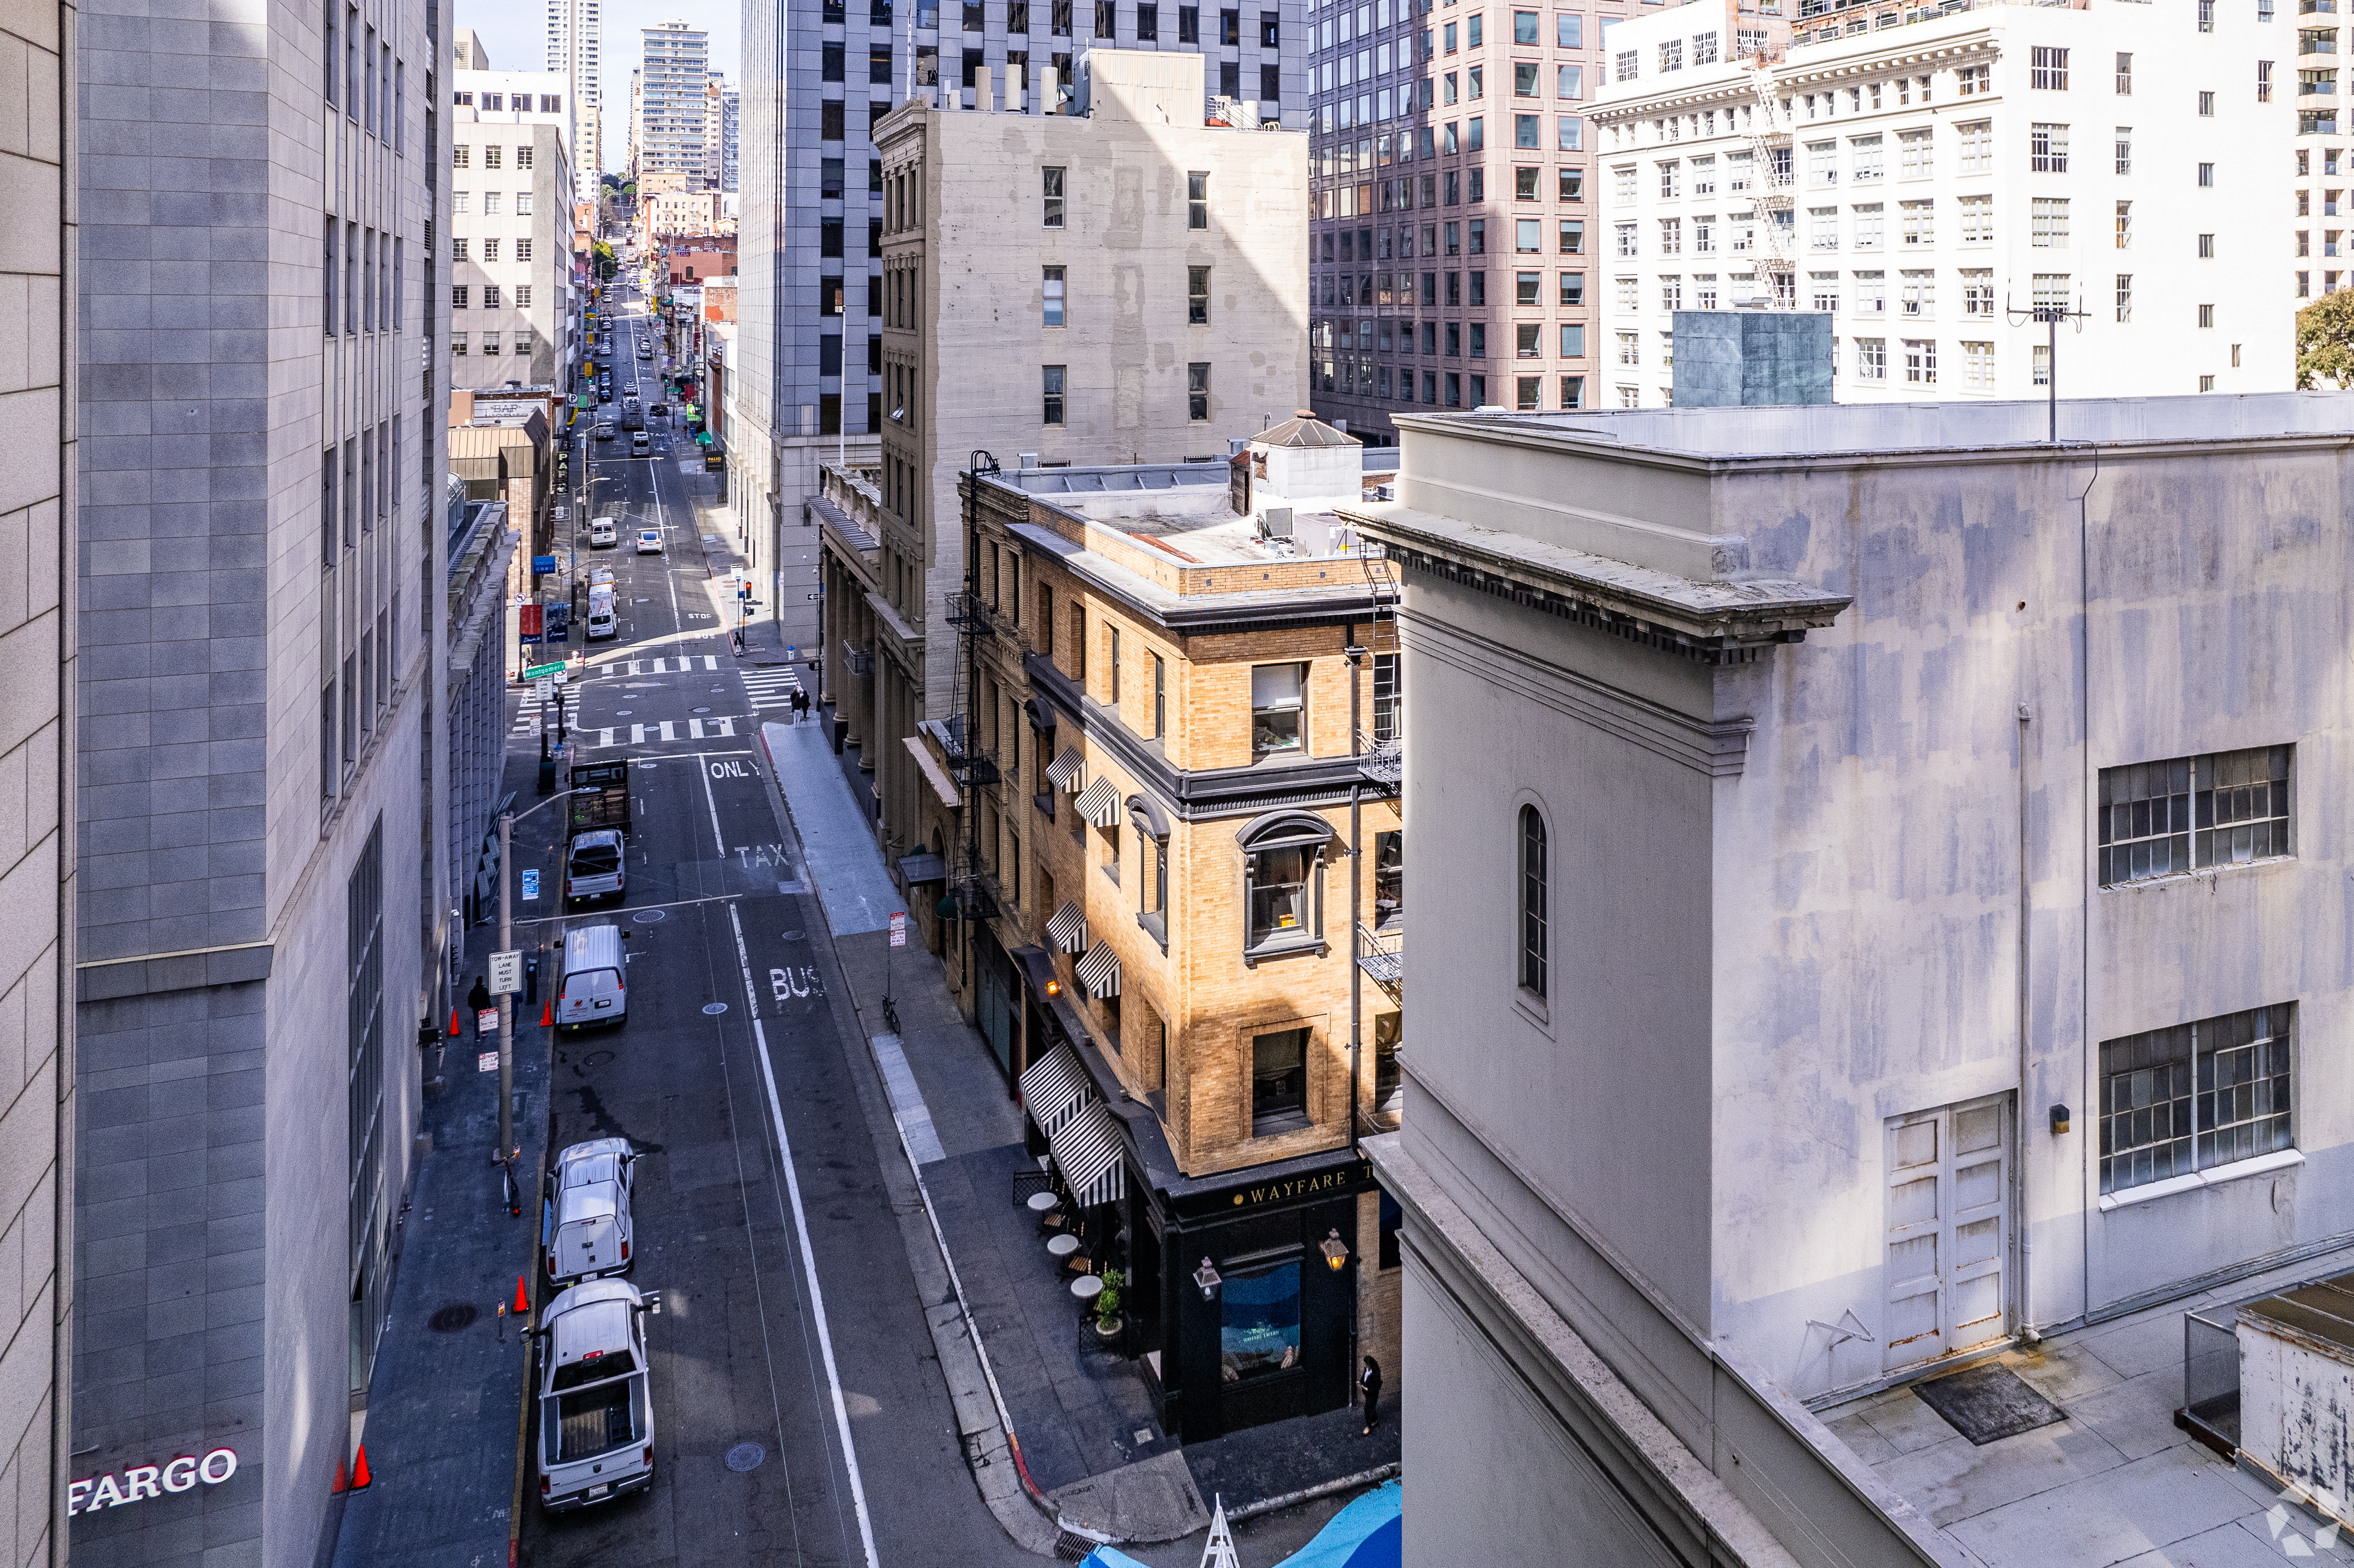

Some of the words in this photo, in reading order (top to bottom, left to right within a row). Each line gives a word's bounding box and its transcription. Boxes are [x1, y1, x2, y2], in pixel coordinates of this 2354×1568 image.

[525, 664, 564, 677] Montgomery
[711, 760, 760, 778] ONLY
[492, 953, 519, 962] TOW-AWAY
[1251, 1172, 1345, 1203] WAYFARE
[1264, 1329, 1279, 1337] TAVERN
[68, 1447, 237, 1516] FARGO
